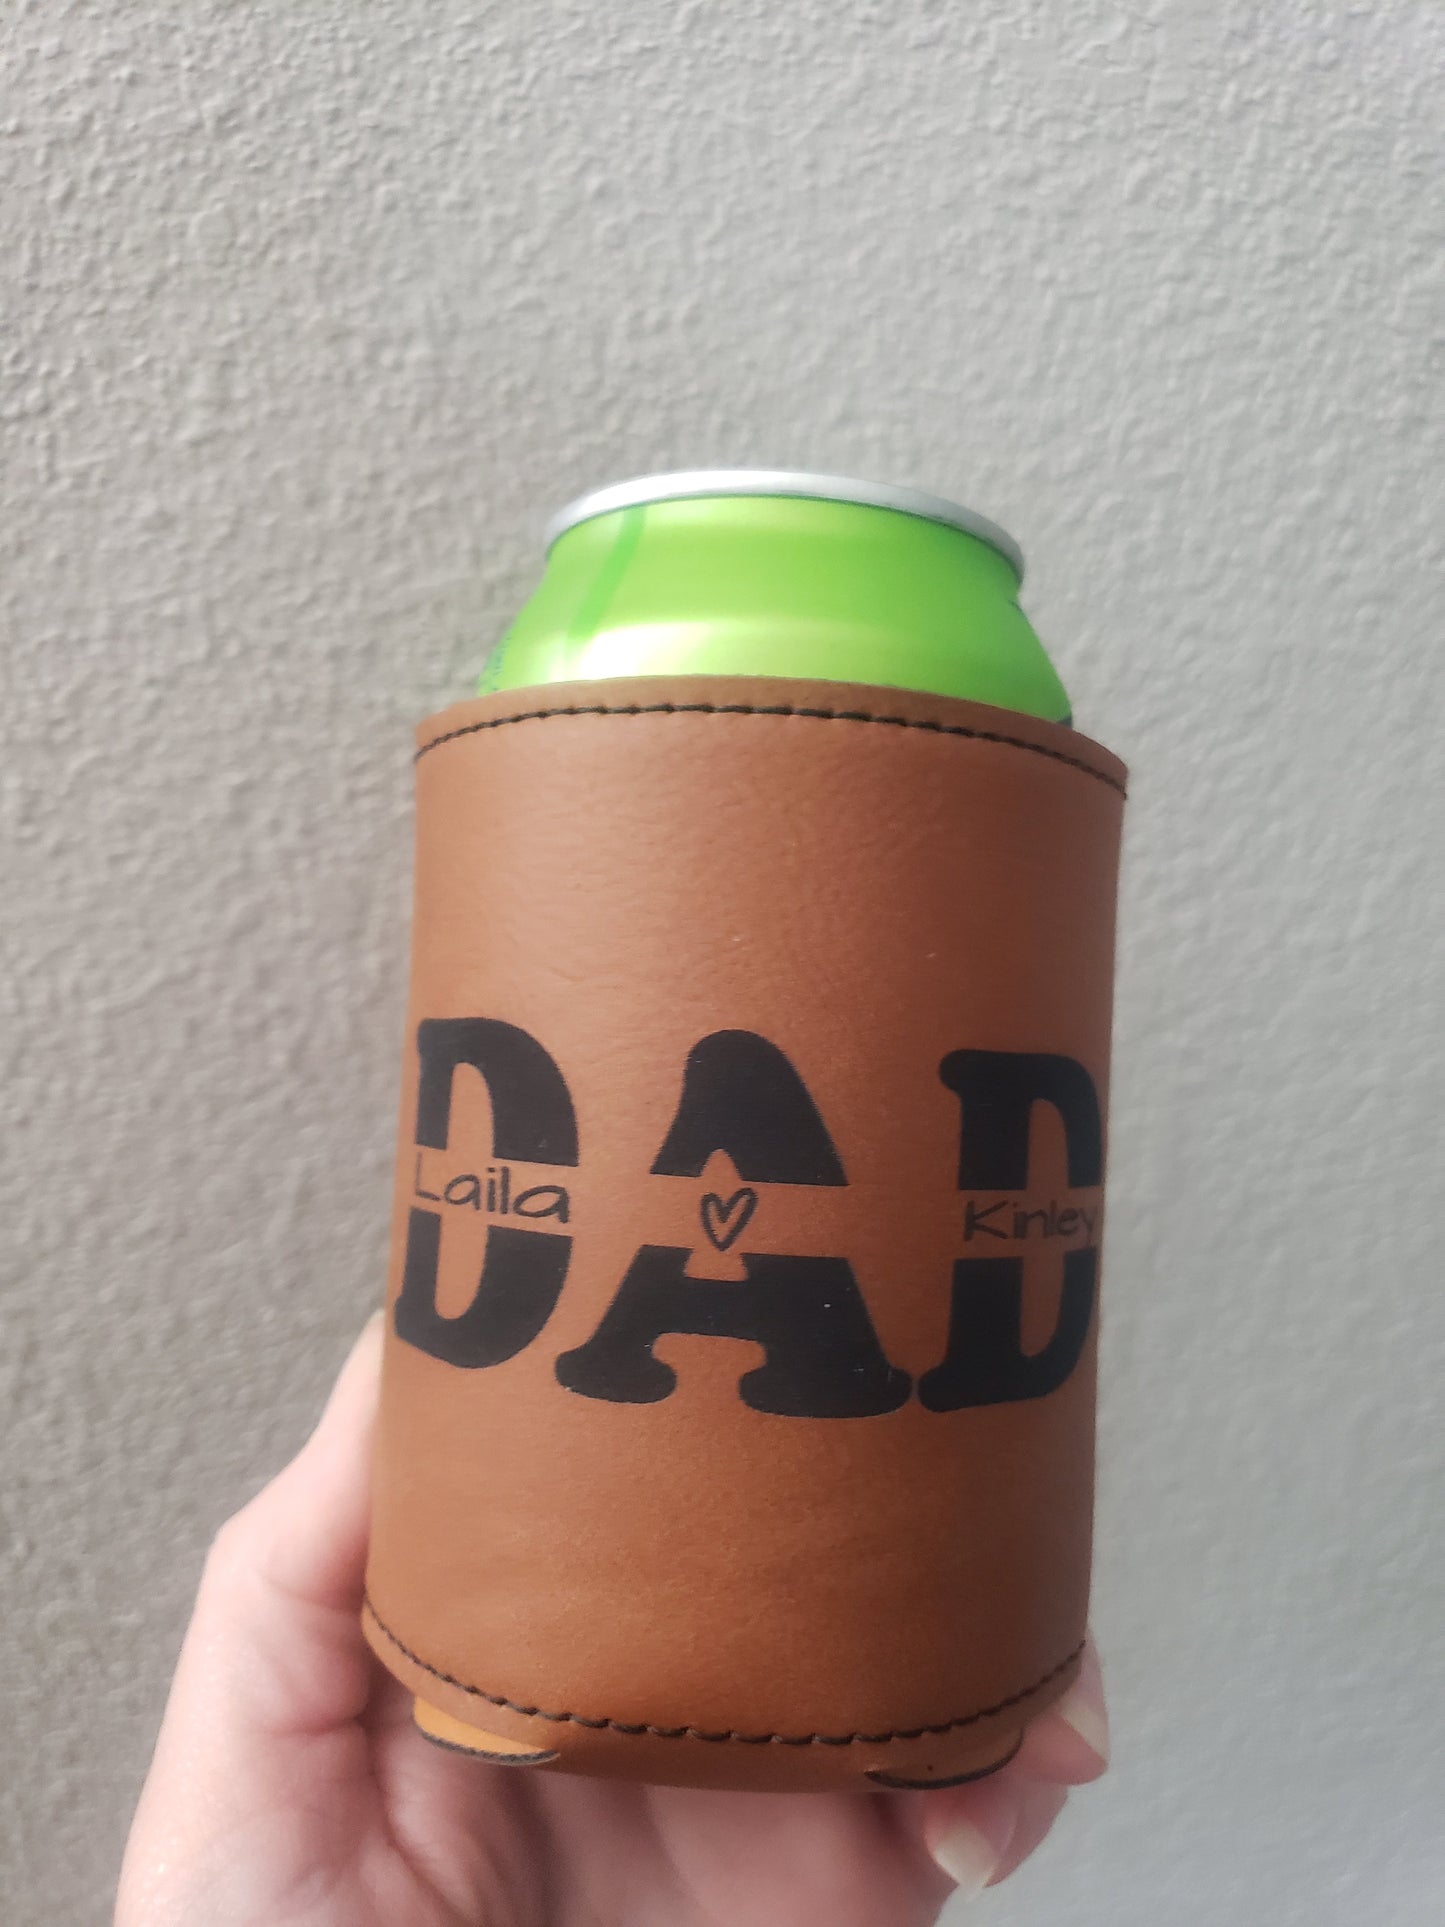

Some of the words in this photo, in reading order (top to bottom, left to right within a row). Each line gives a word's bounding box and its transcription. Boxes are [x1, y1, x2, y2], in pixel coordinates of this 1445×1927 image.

[394, 1016, 1102, 1418] DAD
[415, 1151, 571, 1224] Laila
[963, 1199, 1098, 1247] Kinley
